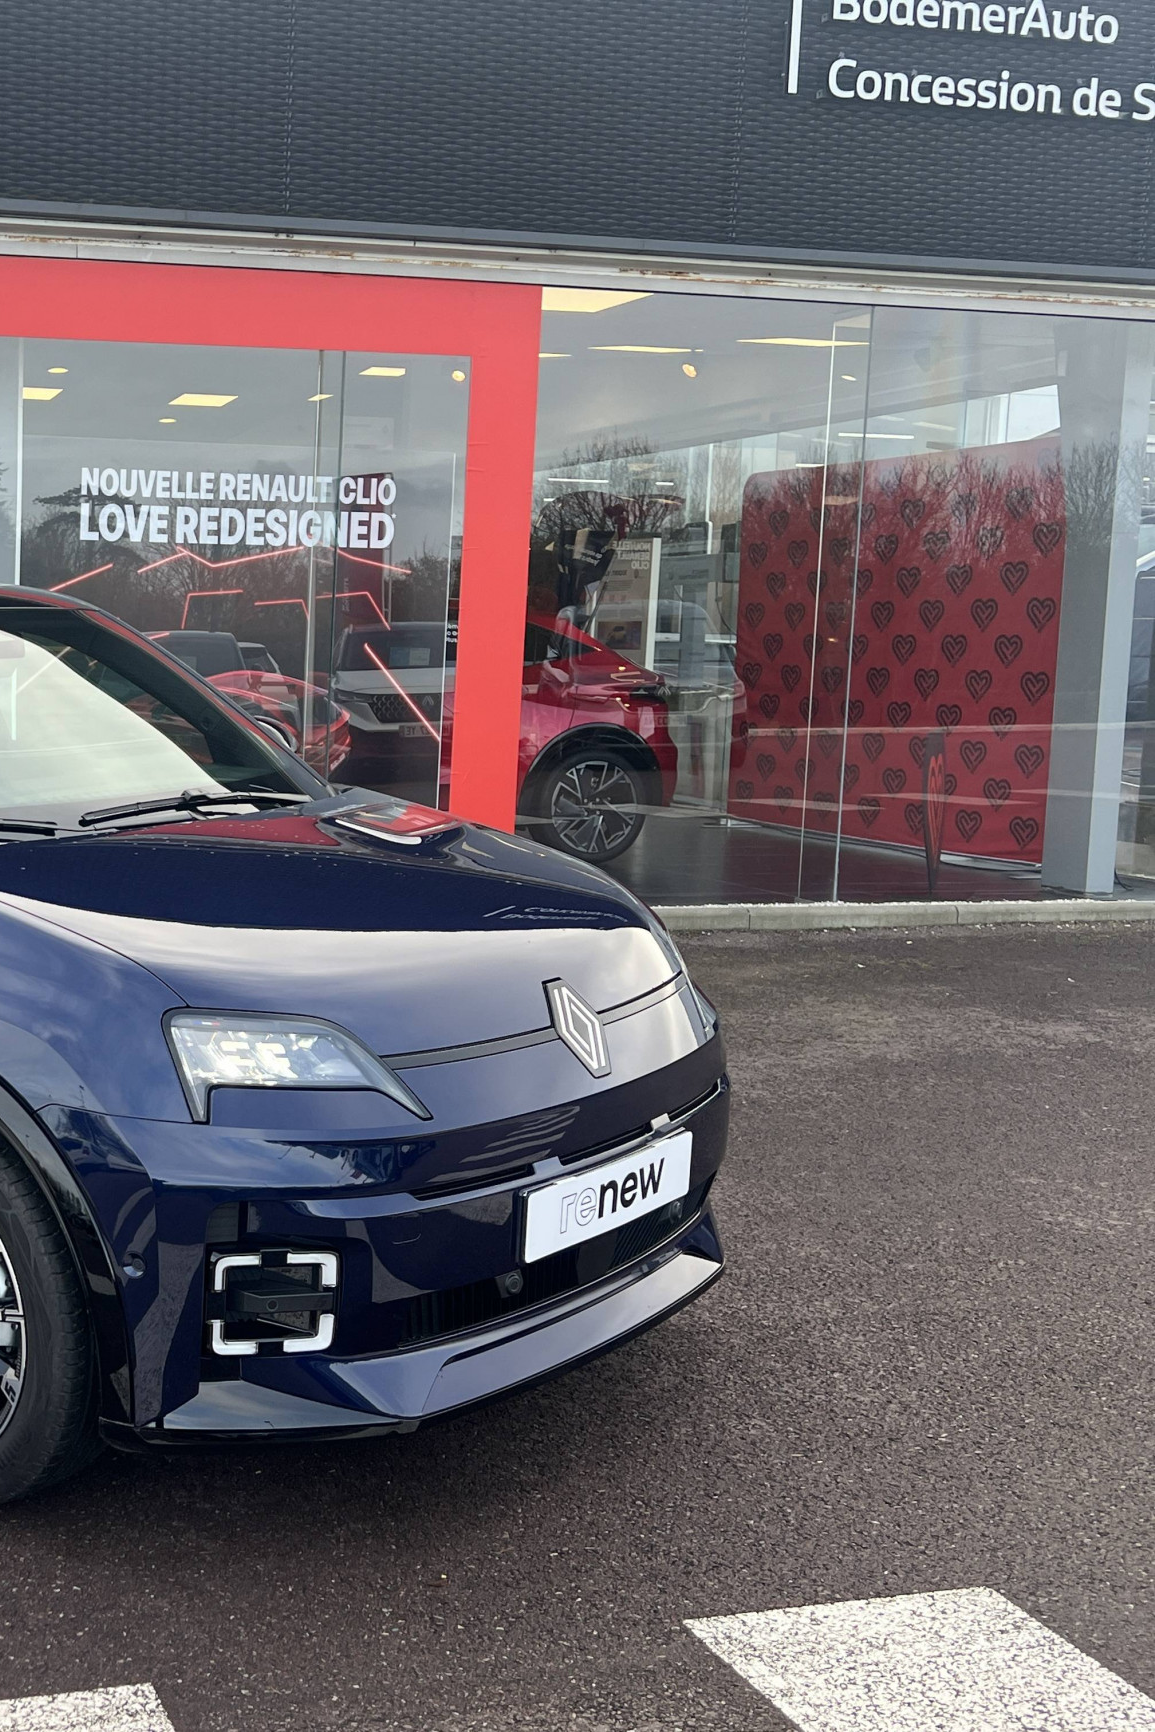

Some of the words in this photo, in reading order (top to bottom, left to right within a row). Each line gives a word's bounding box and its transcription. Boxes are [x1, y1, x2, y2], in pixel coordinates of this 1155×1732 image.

[828, 58, 1062, 114] Concession
[1072, 77, 1122, 118] de
[81, 467, 215, 500] NOUVELLE
[219, 472, 333, 504] RENAULT
[339, 476, 397, 506] CLIO
[79, 503, 169, 544] LOVE
[560, 1157, 665, 1235] renew
